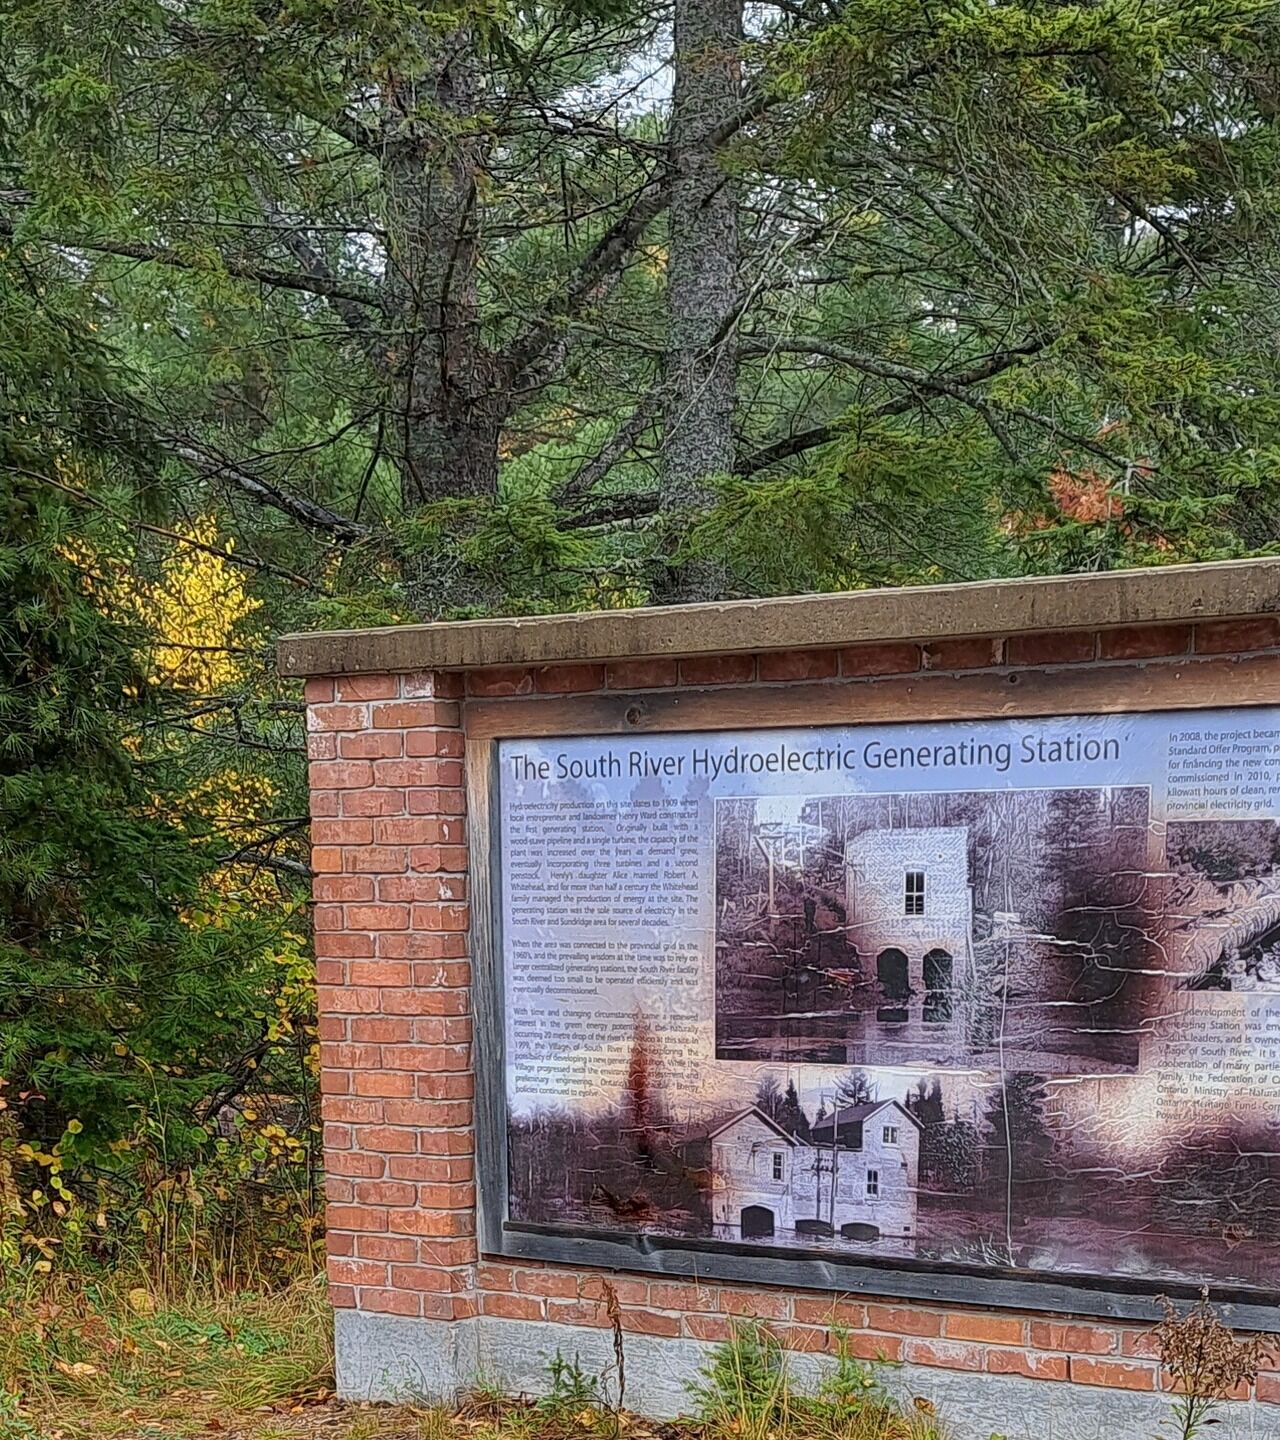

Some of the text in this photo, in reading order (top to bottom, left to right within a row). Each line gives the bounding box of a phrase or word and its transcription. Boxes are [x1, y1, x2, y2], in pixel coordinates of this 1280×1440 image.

[1169, 731, 1178, 742] In
[1204, 730, 1219, 740] the
[1219, 729, 1251, 742] project
[1168, 744, 1207, 755] Standard
[1208, 743, 1230, 753] Offer
[1231, 741, 1272, 755] Program,
[510, 733, 1119, 781] The South River Hydroelectric Generating Station
[1168, 758, 1180, 769] for
[1182, 757, 1223, 771] financing
[1225, 756, 1240, 767] the
[1242, 758, 1261, 766] new
[1167, 771, 1230, 783] commissioned
[1233, 771, 1243, 780] in
[1247, 769, 1272, 781] 2010,
[1166, 786, 1201, 796] kilowatt
[1203, 785, 1228, 795] hours
[1229, 784, 1239, 794] of
[1240, 784, 1266, 795] clean,
[1166, 797, 1274, 813] provincial electricity grid.
[1250, 1007, 1260, 1017] of
[1265, 1008, 1280, 1017] the
[1210, 1020, 1240, 1030] Station
[1225, 1034, 1241, 1043] and
[1244, 1035, 1251, 1043] is
[1188, 1046, 1199, 1055] of
[1201, 1046, 1226, 1056] South
[1269, 1048, 1275, 1057] is
[1212, 1060, 1222, 1069] of
[1226, 1063, 1250, 1072] many
[1189, 1072, 1203, 1081] the
[1207, 1073, 1253, 1083] Federation
[1257, 1074, 1268, 1084] of
[1156, 1084, 1188, 1094] Ontario
[1194, 1085, 1228, 1098] Ministry
[1234, 1087, 1246, 1096] of
[1248, 1087, 1280, 1097] Natural
[1234, 1100, 1257, 1109] Fund
